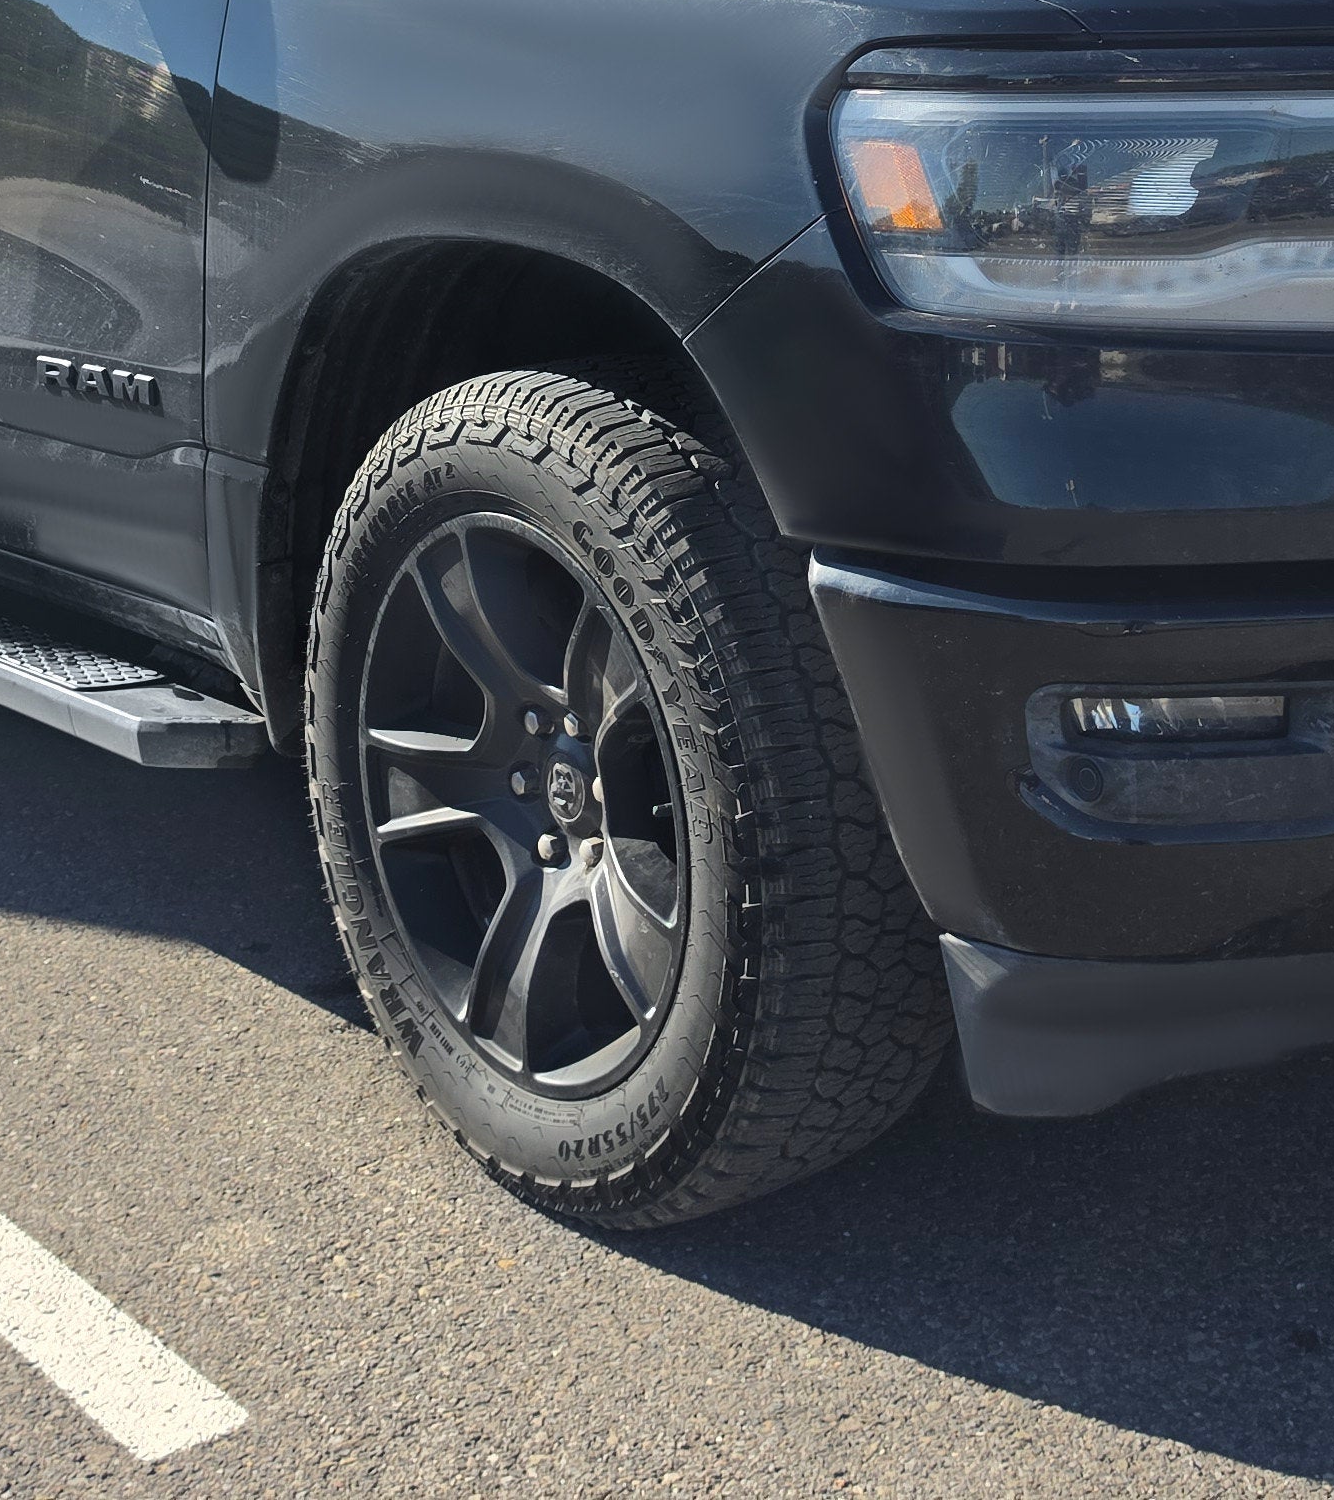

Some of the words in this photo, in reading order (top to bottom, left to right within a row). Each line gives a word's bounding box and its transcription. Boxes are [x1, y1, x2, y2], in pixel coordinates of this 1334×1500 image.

[36, 355, 160, 408] RAM
[323, 784, 424, 1060] WRANGLER
[558, 1075, 670, 1162] 275/55R20
